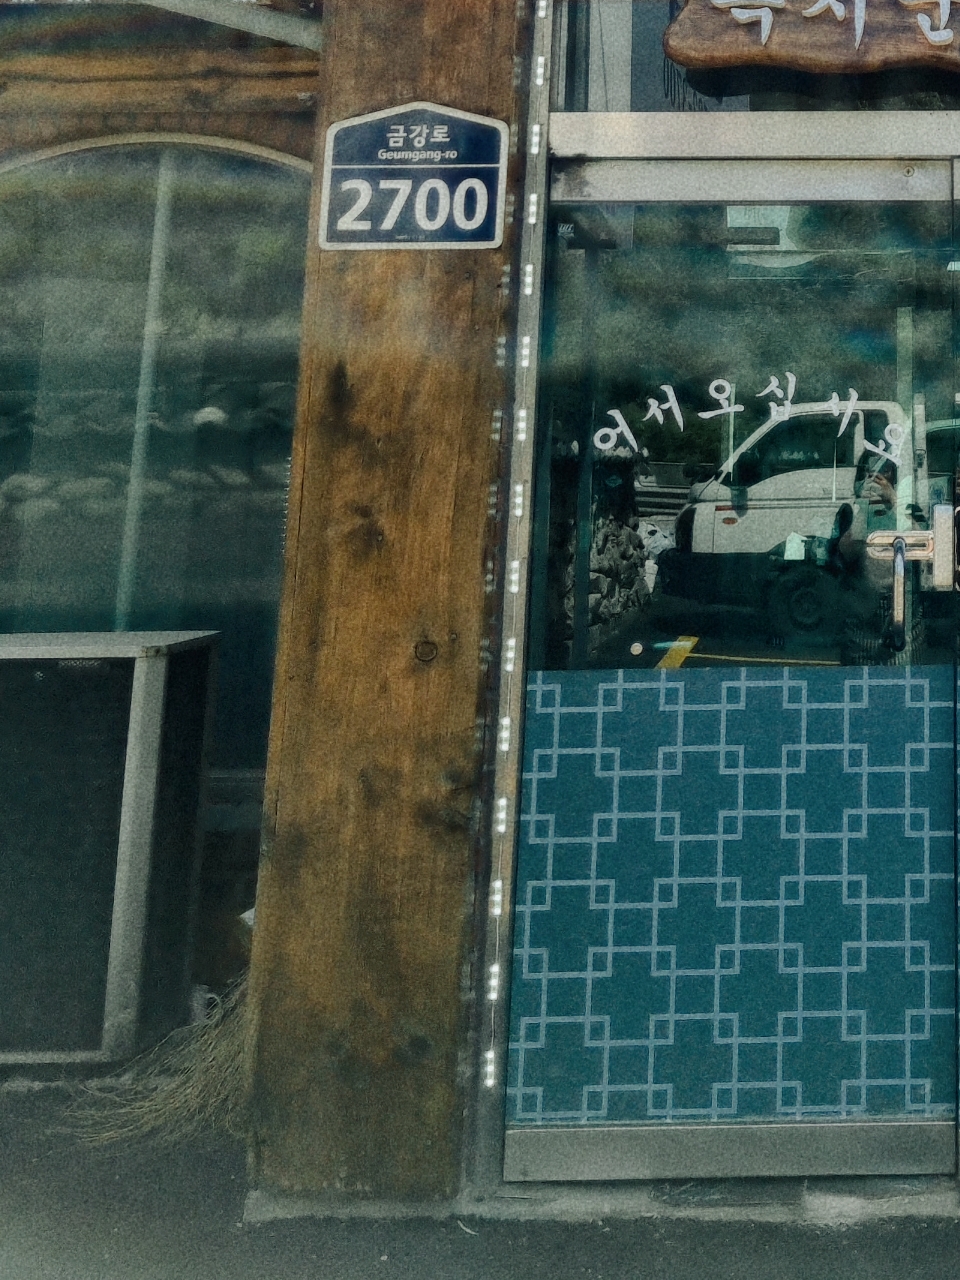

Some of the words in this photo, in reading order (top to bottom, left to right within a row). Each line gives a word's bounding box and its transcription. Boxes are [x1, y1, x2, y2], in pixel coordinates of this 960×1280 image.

[386, 124, 451, 148] 금강로
[377, 148, 458, 162] Geumgang-ro
[336, 178, 489, 231] 2700
